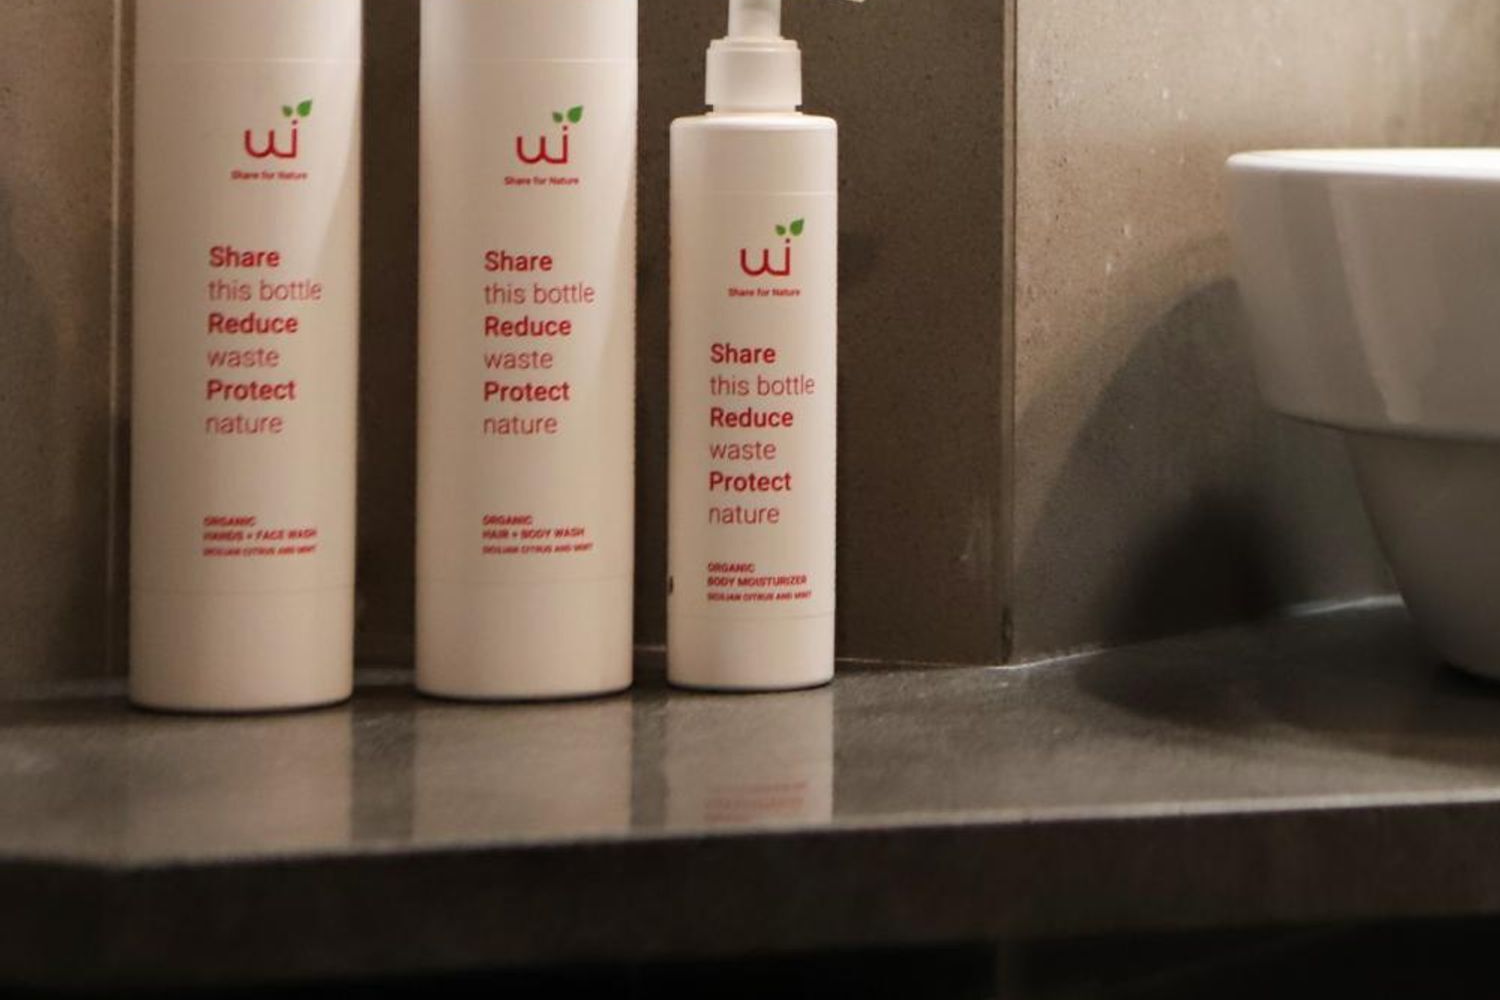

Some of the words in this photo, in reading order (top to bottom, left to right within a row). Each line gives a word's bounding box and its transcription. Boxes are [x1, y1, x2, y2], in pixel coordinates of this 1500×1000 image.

[504, 176, 531, 186] Share
[209, 244, 280, 268] Share
[484, 249, 553, 271] Share
[208, 278, 252, 301] this
[259, 278, 322, 301] bottle
[484, 282, 526, 305] this
[533, 282, 595, 304] bottle
[728, 287, 755, 297] Share
[757, 287, 770, 297] for
[772, 288, 801, 297] Nature
[207, 312, 298, 334] Reduce
[484, 315, 572, 337] Reduce
[207, 349, 279, 368] waste
[484, 350, 553, 369] waste
[710, 342, 776, 364] Share
[206, 379, 297, 400] Protect
[484, 380, 570, 402] Protect
[709, 374, 750, 396] this
[757, 373, 816, 396] bottle
[205, 413, 283, 434] nature
[483, 415, 557, 435] nature
[710, 406, 793, 428] Reduce
[709, 440, 777, 460] waste
[709, 470, 792, 492] Protect
[203, 516, 256, 528] ORGANIC
[482, 514, 533, 526] ORGANIC
[708, 504, 780, 524] nature
[256, 530, 284, 540] FACE
[482, 529, 509, 539] HAIR
[520, 529, 551, 539] BODY
[554, 527, 584, 538] WASH
[707, 562, 756, 573] ORGANIC
[707, 576, 735, 587] BODY
[737, 575, 807, 587] MOISTURIZER
